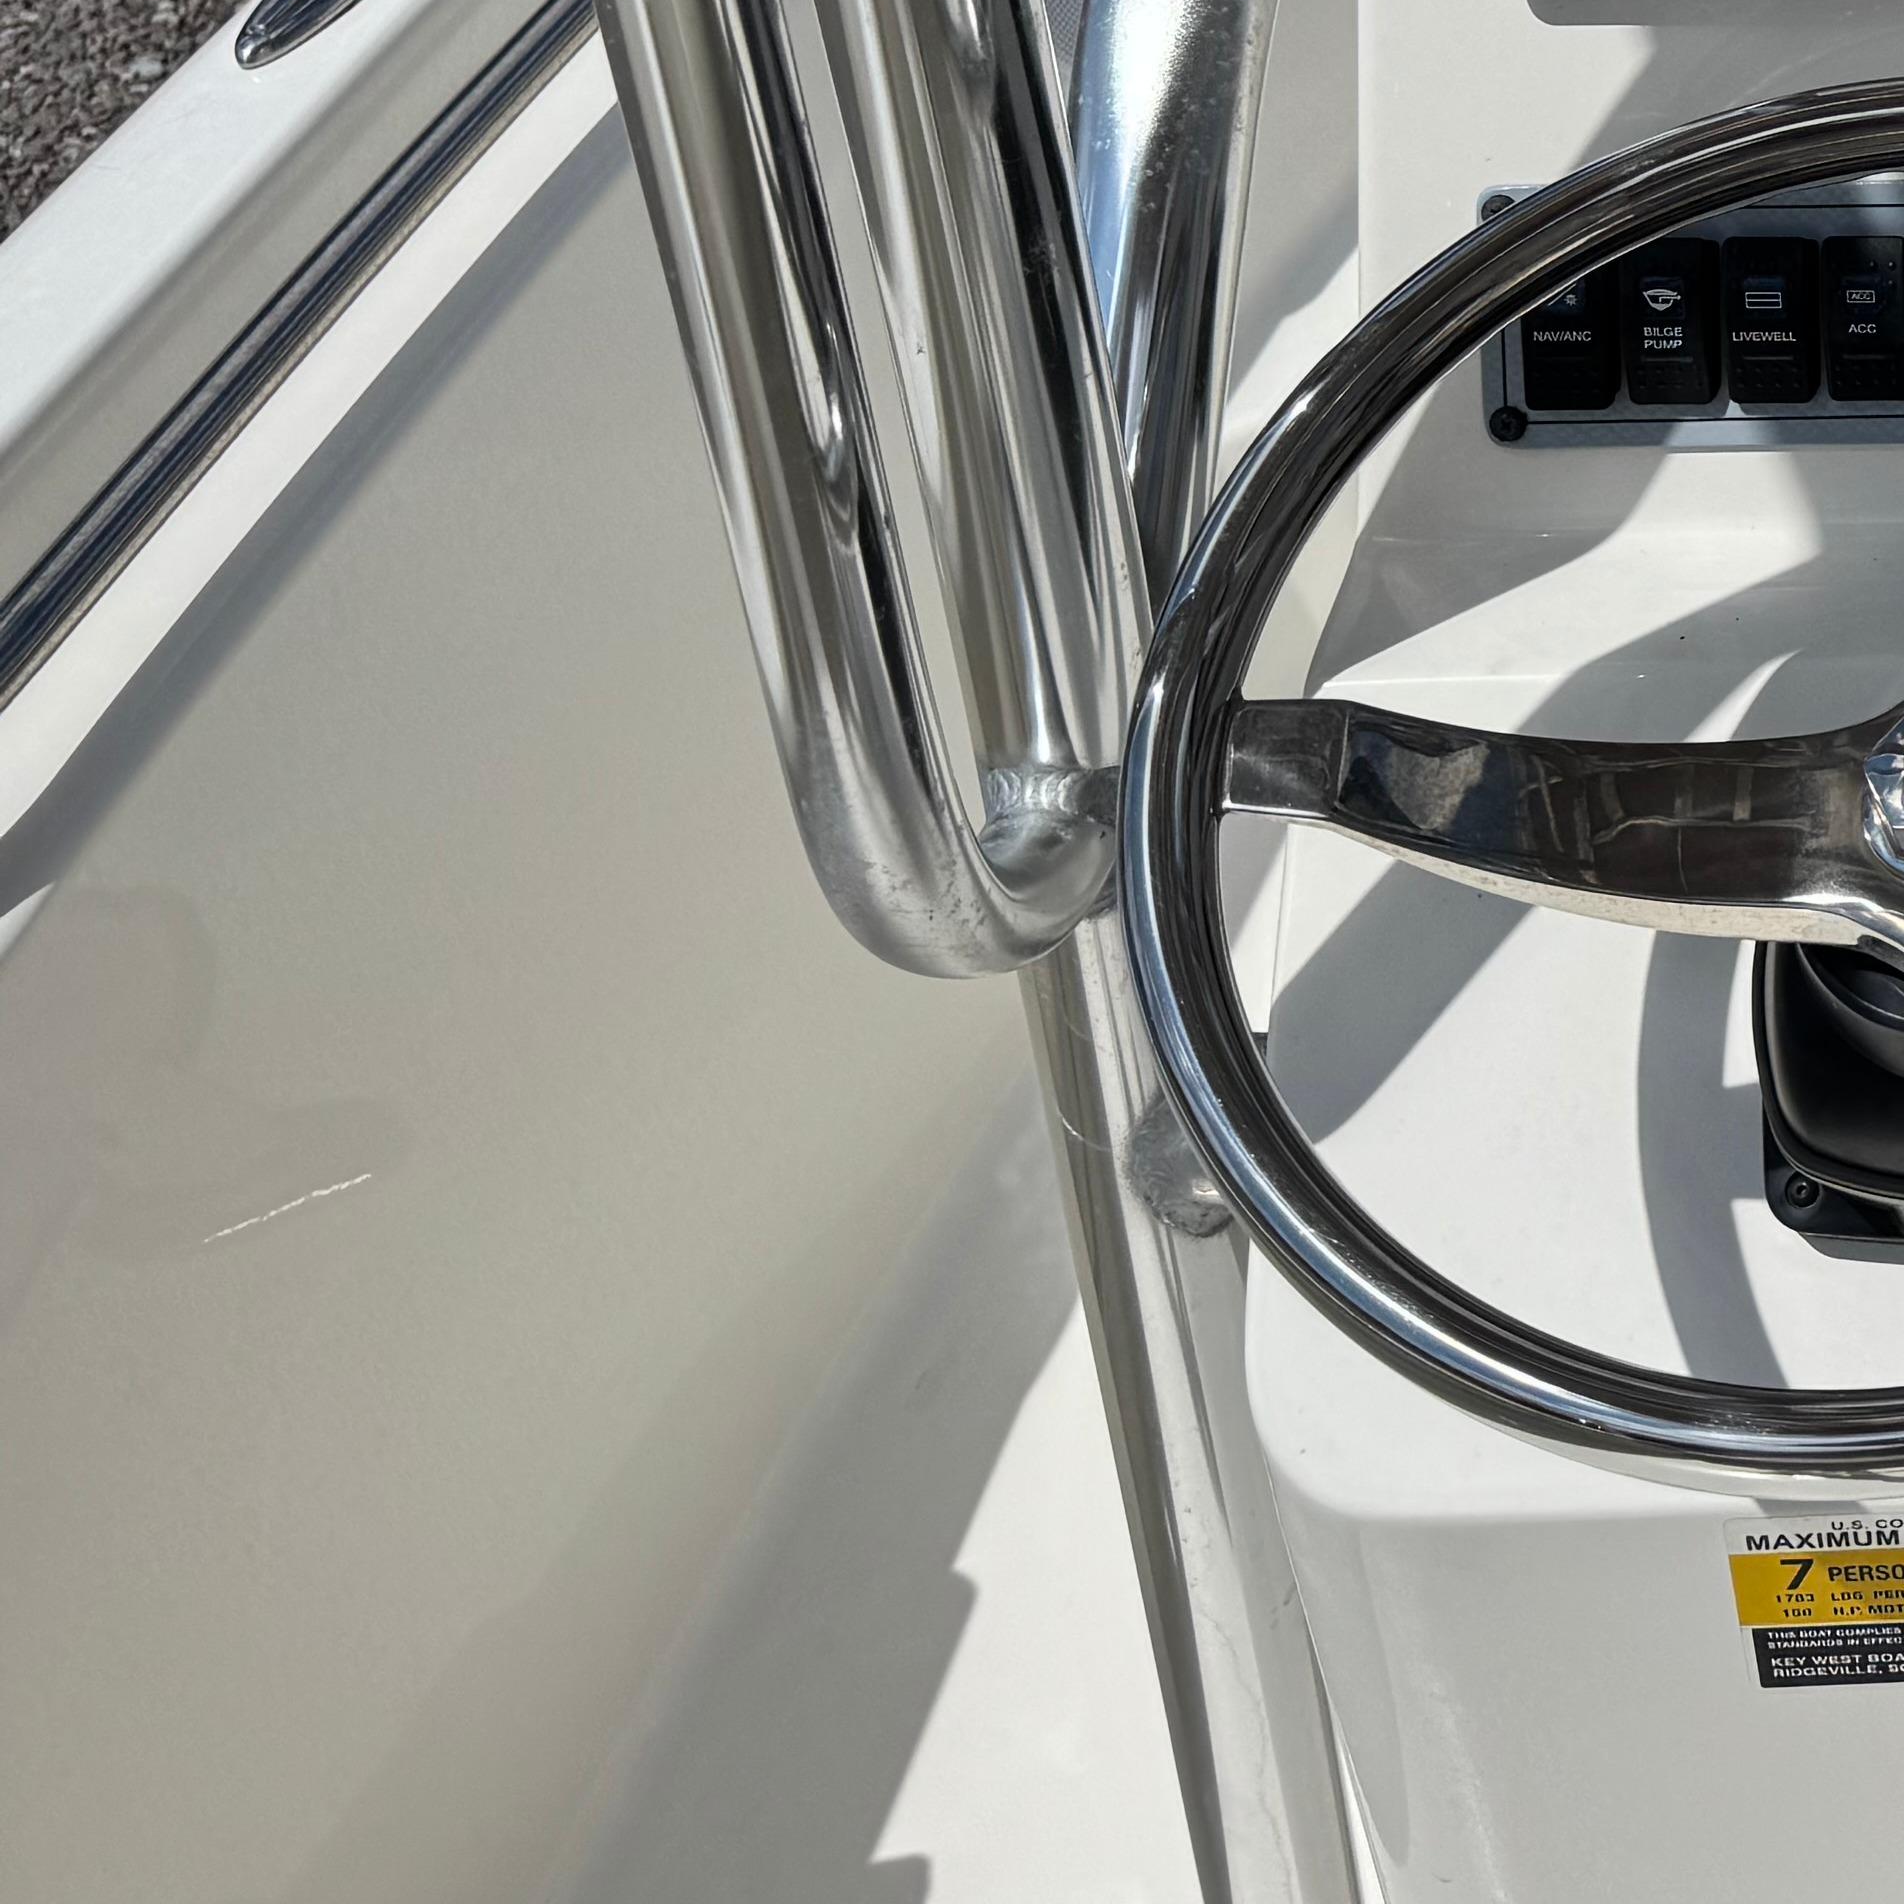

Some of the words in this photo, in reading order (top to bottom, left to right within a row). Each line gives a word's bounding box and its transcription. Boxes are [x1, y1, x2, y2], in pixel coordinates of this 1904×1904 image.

[1643, 326, 1684, 338] BILGE
[1848, 323, 1877, 334] ACC
[1533, 330, 1592, 343] NAV/ANC
[1732, 331, 1797, 342] LIVEWELL
[1643, 338, 1684, 350] PUMP
[1831, 1520, 1868, 1531] U.S.
[1745, 1529, 1900, 1551] MAXIMUM
[1779, 1558, 1814, 1591] 7
[1771, 1655, 1806, 1668] KEY
[1811, 1653, 1863, 1665] WEST
[1773, 1664, 1884, 1679] RIDGEVILLE,
